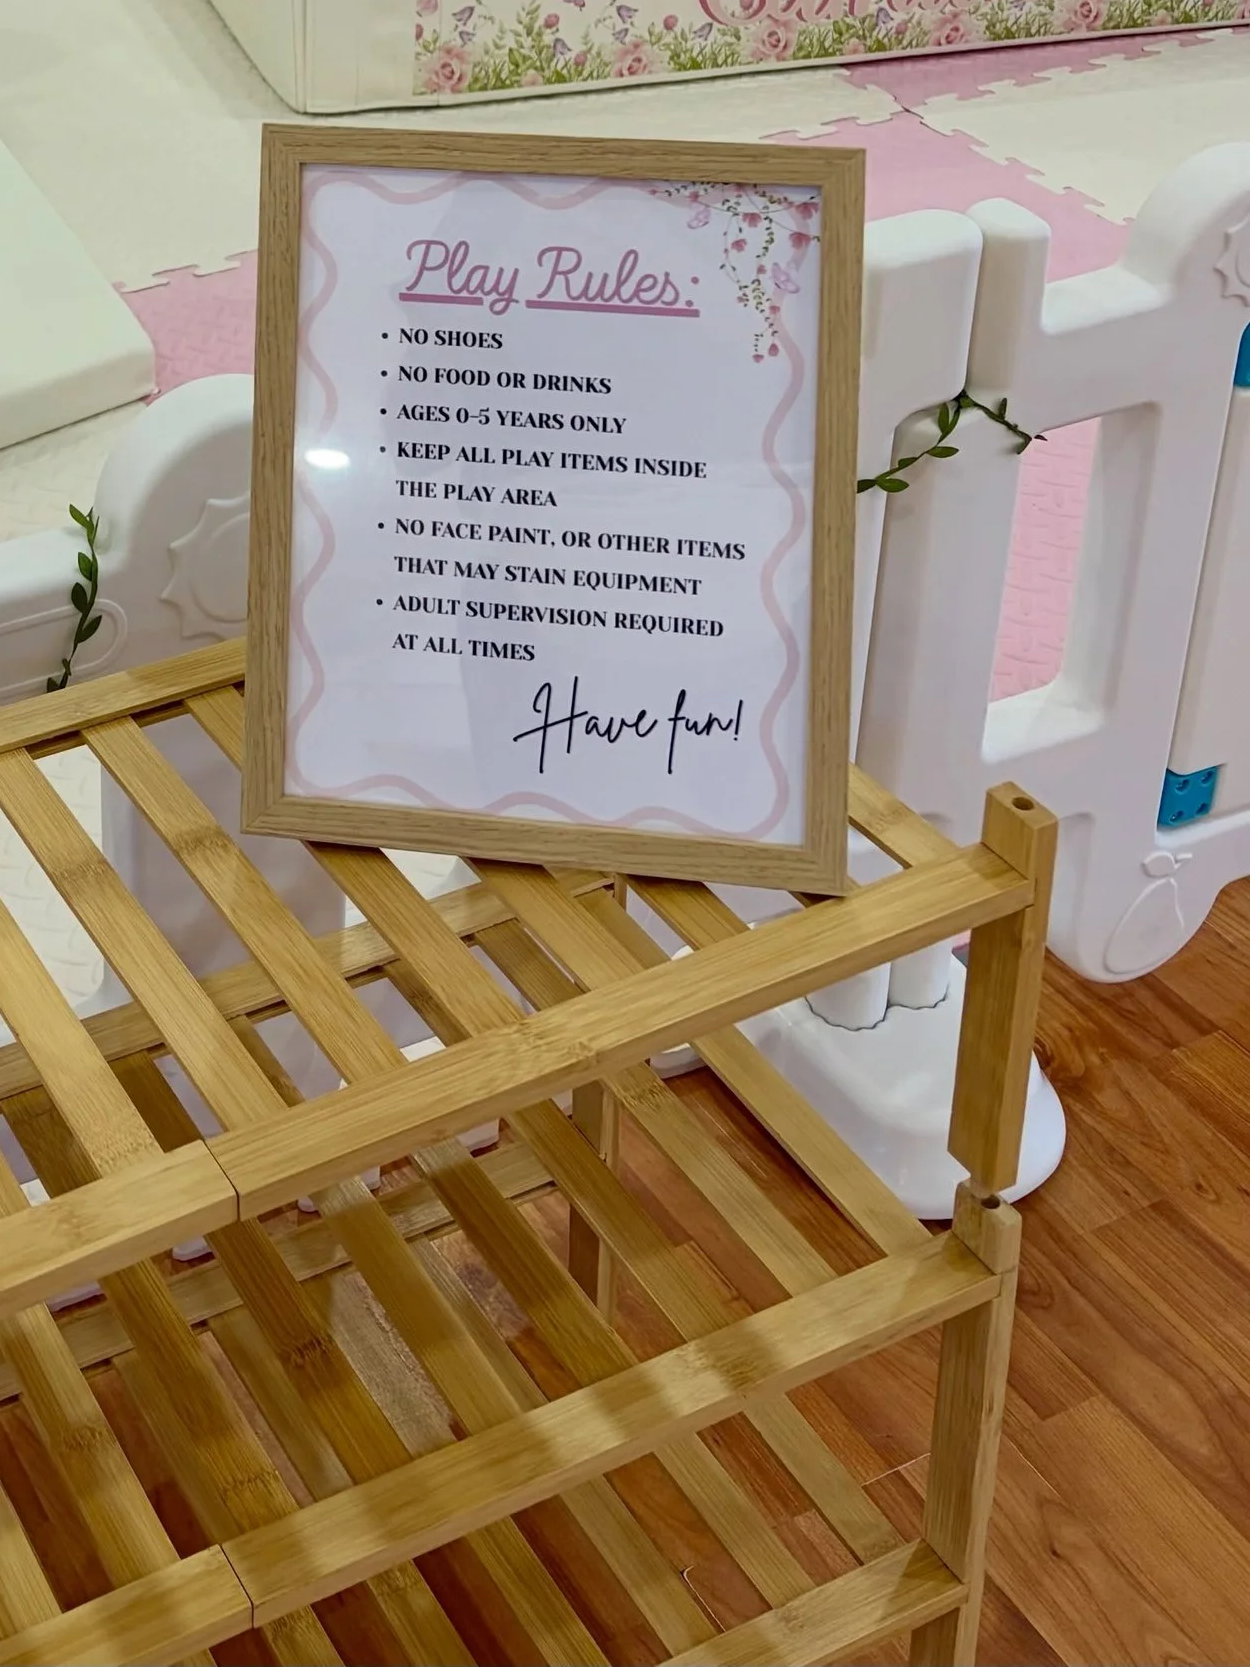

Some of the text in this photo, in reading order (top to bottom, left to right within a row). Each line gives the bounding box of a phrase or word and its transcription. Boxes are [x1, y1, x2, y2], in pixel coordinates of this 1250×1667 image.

[405, 239, 700, 316] Play Rules:
[399, 327, 504, 350] NO SHOES
[398, 365, 612, 395] NO FOOD OR DRINKS
[396, 404, 451, 423] AGES
[497, 409, 565, 430] YEARS
[570, 414, 627, 434] ONLY
[397, 441, 707, 479] KEEP ALL PLAY ITEMS INSIDE
[395, 480, 558, 507] THE PLAY AREA
[395, 518, 746, 560] NO FACE PAINT, OR OTHER ITEMS
[394, 555, 702, 596] THAT MAY STAIN EQUIPMENT
[392, 594, 724, 637] ADULT SUPERVISION REQUIRED
[392, 633, 536, 661] AT ALL TIMES
[513, 675, 744, 774] Have fun!
